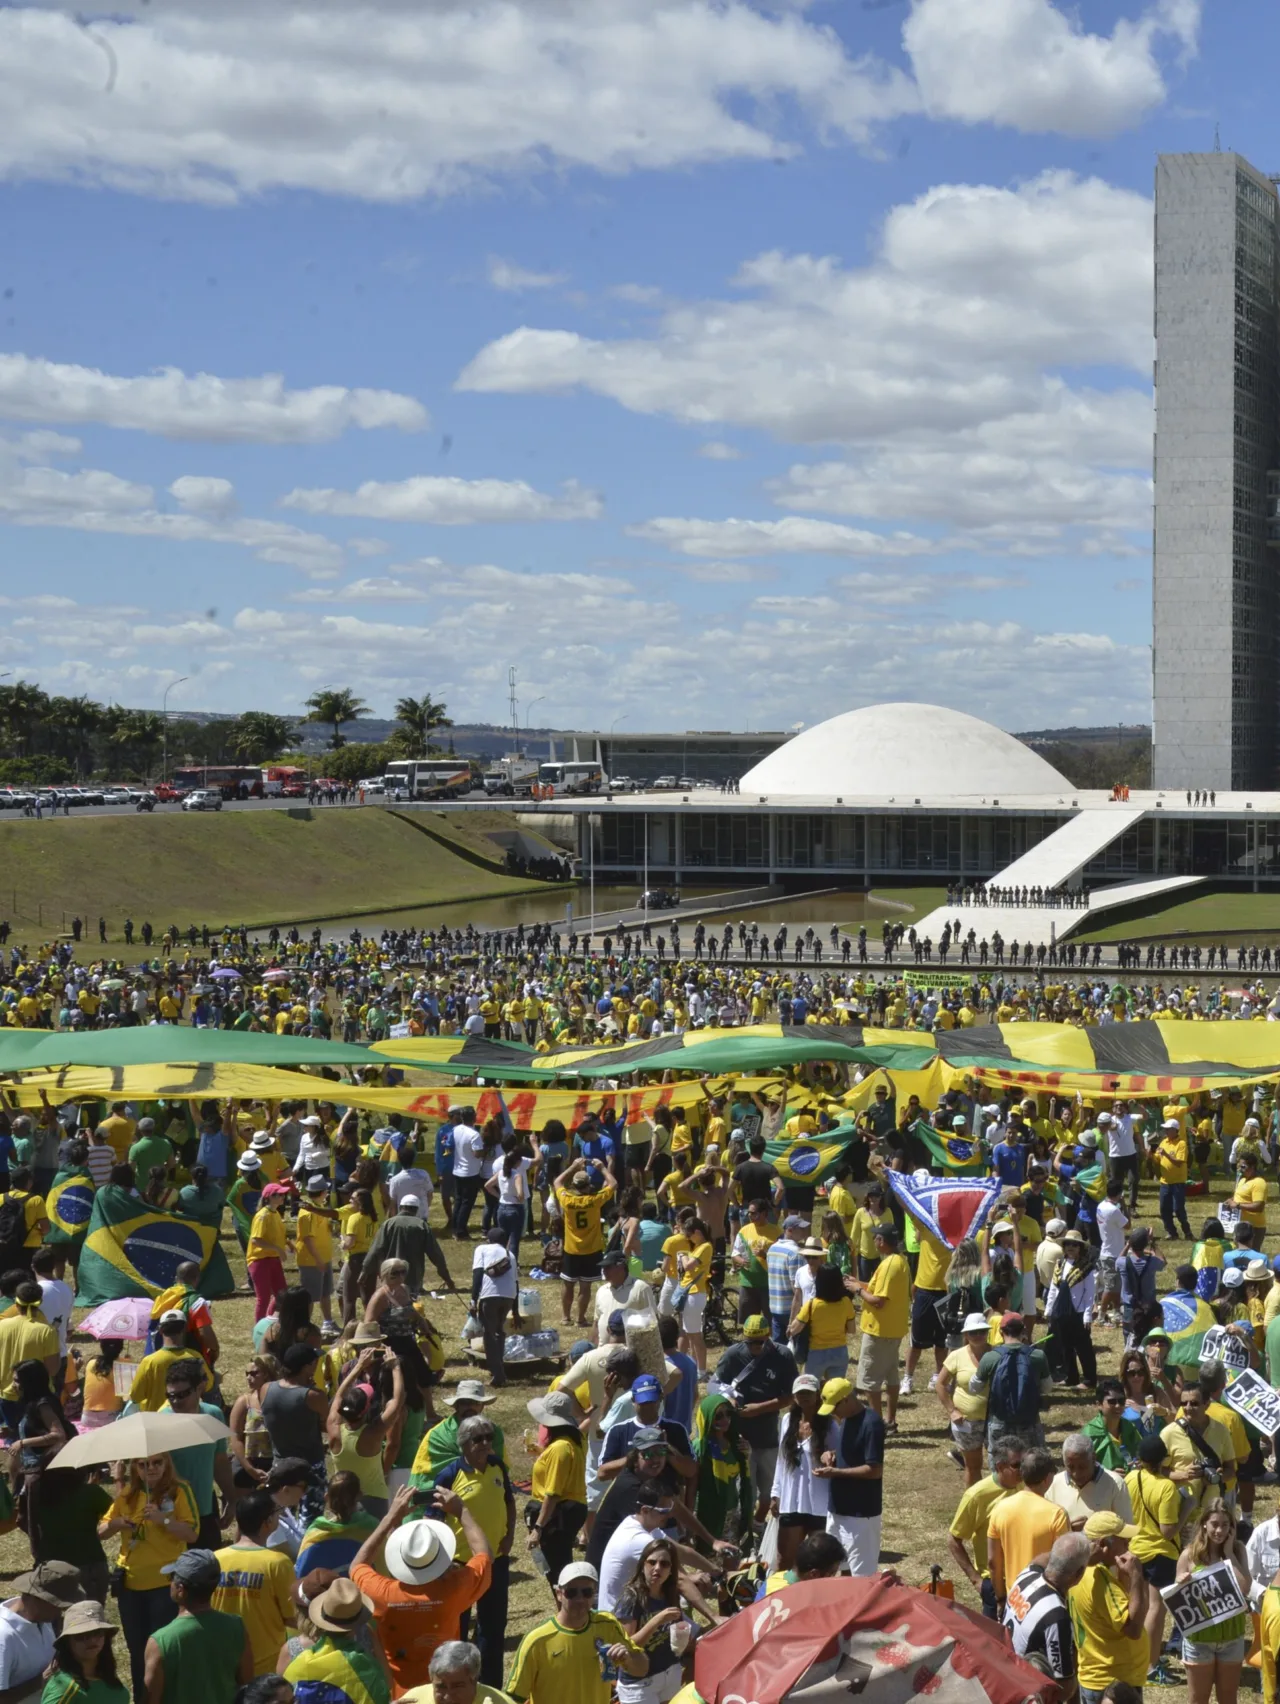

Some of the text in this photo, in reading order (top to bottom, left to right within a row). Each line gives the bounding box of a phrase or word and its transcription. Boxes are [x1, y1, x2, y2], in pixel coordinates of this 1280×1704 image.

[576, 1211, 588, 1229] 6
[1203, 1339, 1246, 1368] Dilma
[1227, 1382, 1276, 1431] Dilma
[1006, 1586, 1032, 1623] BMG
[1180, 1574, 1220, 1608] FORA
[1174, 1592, 1240, 1630] Dilma
[1049, 1640, 1062, 1676] MRV
